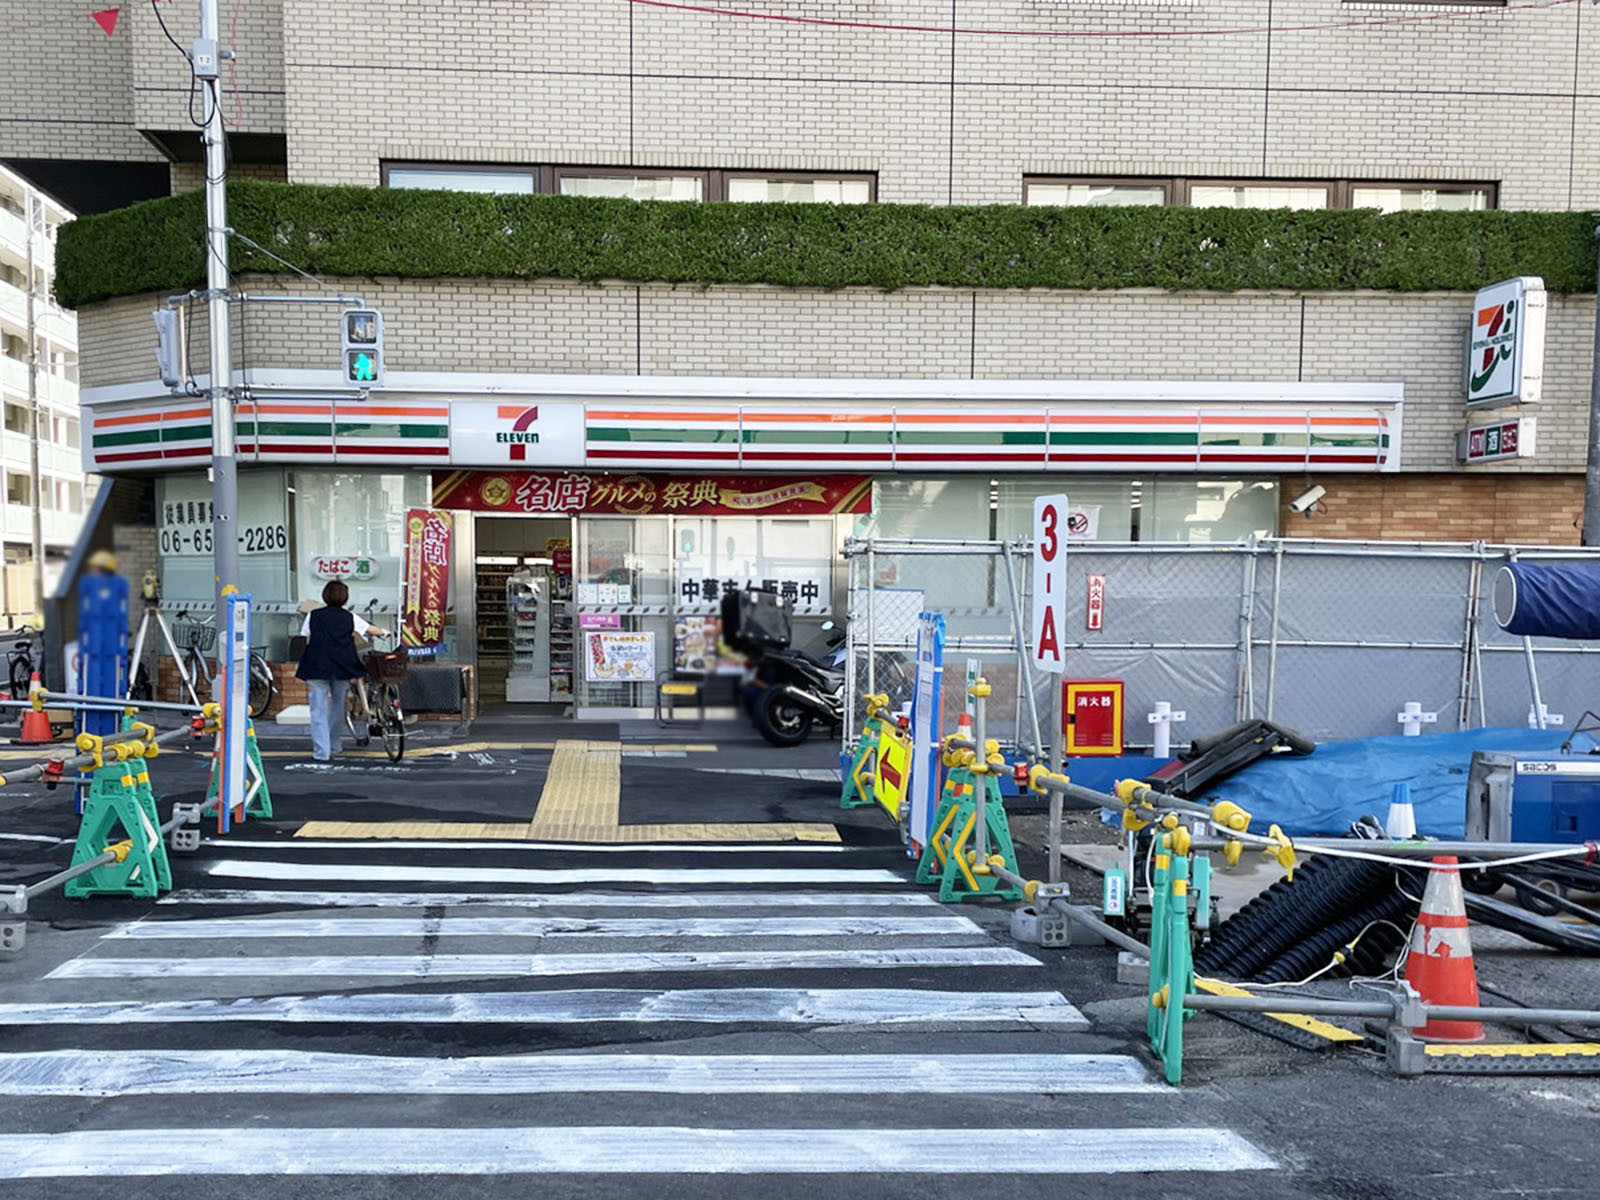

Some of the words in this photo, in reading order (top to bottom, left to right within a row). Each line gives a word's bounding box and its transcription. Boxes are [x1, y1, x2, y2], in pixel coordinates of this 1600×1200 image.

[161, 525, 286, 553] 06-65-2286
[318, 560, 351, 574] たばこ
[355, 560, 371, 574] 酒
[1077, 696, 1111, 707] 消火器
